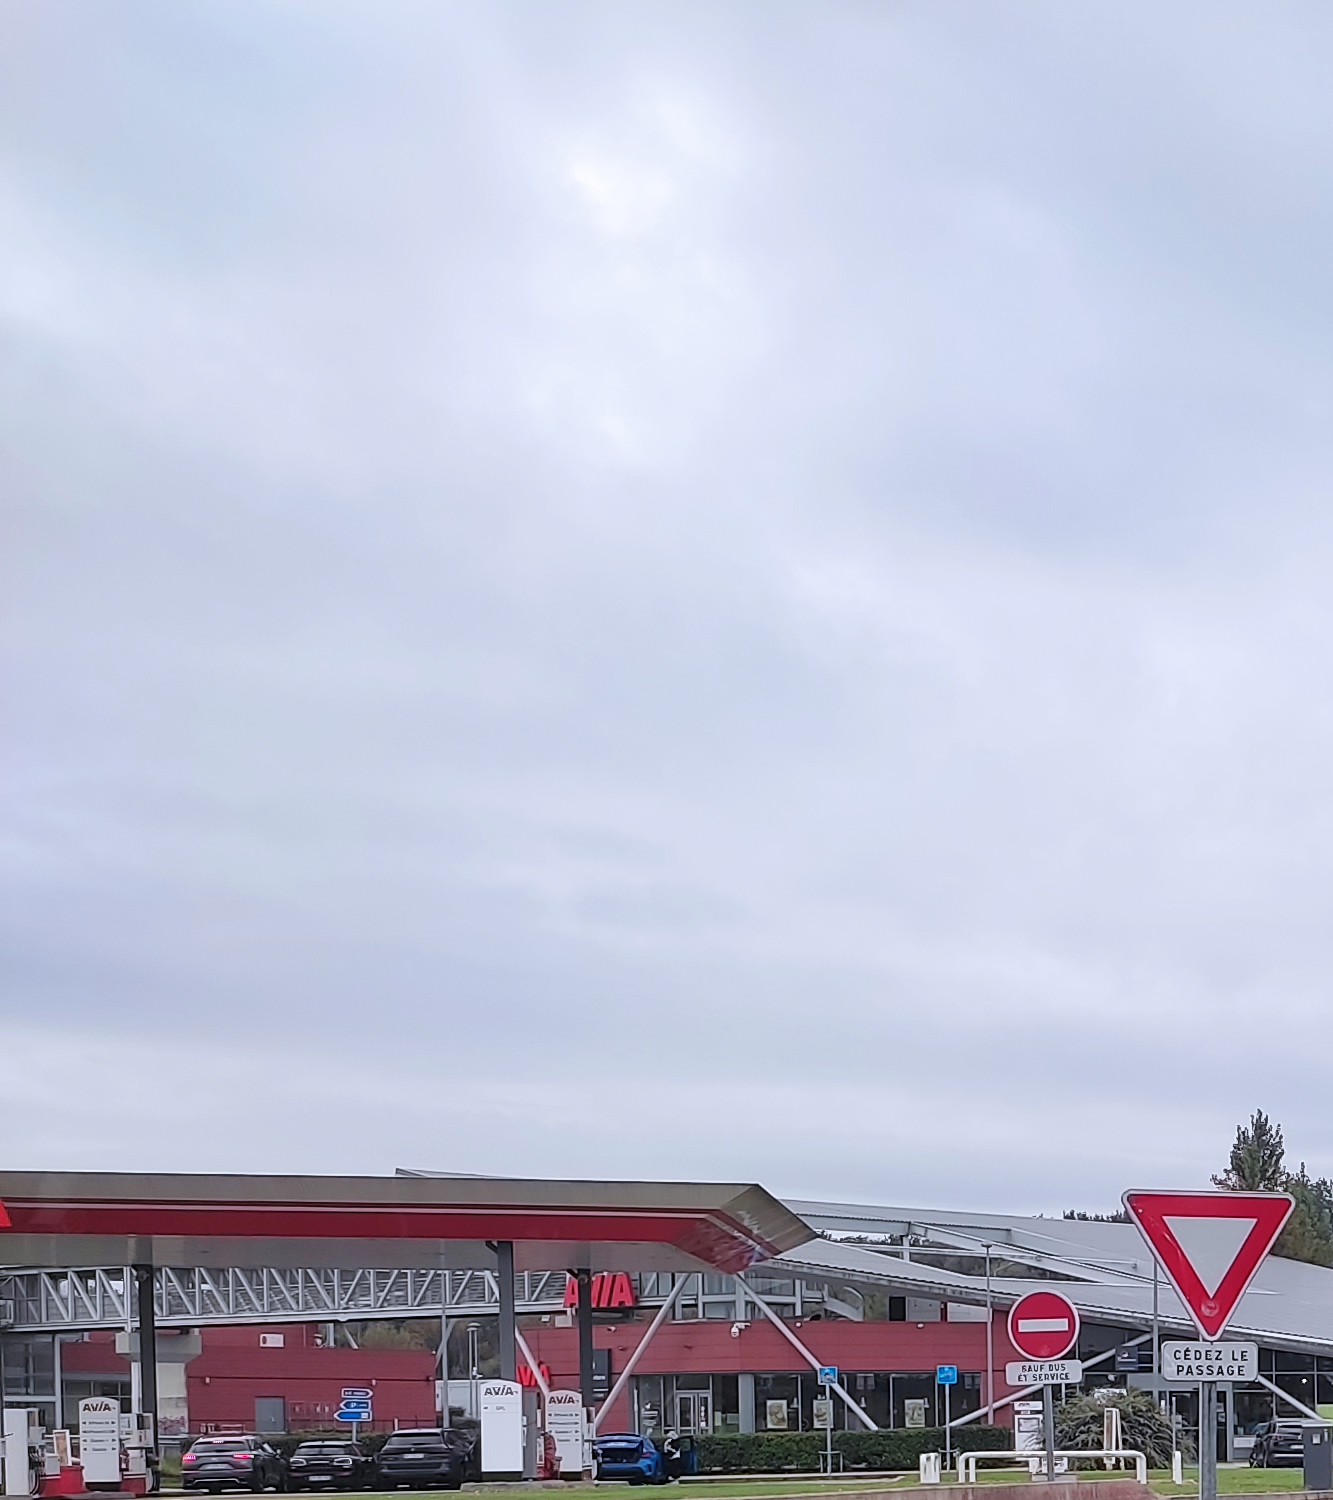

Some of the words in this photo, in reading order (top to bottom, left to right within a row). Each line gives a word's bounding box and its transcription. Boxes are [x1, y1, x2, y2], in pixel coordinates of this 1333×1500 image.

[1173, 1347, 1223, 1361] CÉDEZ
[1231, 1350, 1249, 1361] LE
[1176, 1364, 1246, 1376] PASSAGE
[1017, 1374, 1028, 1382] ET
[1032, 1372, 1070, 1382] SERVICE
[484, 1385, 514, 1396] AVIA
[548, 1394, 576, 1405] AVIA
[82, 1401, 112, 1412] AVIA
